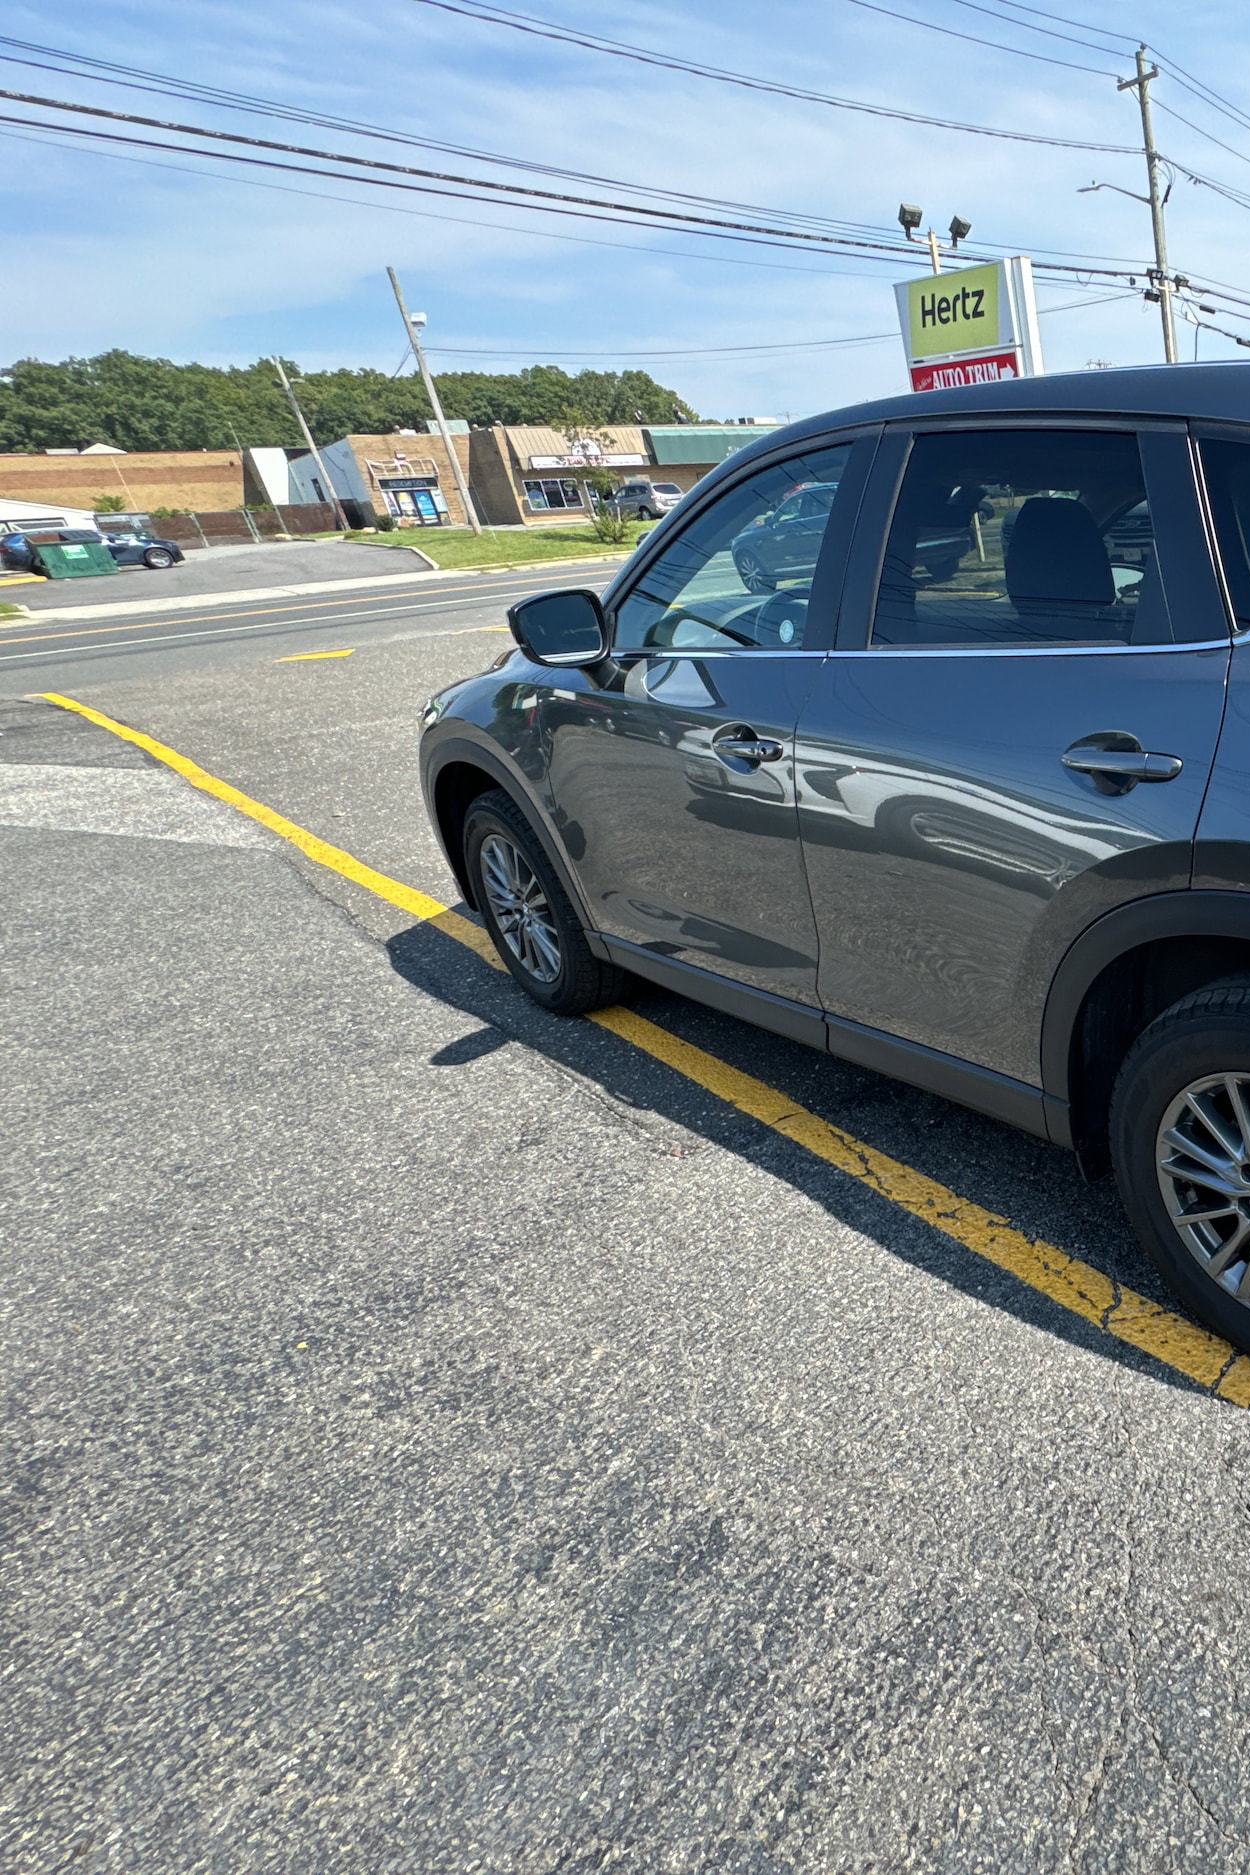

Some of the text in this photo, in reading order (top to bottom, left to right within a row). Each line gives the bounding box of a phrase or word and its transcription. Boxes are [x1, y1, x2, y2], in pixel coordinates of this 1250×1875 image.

[920, 287, 985, 328] Hertz
[932, 367, 965, 390] AUTO
[965, 362, 1001, 384] TRIM
